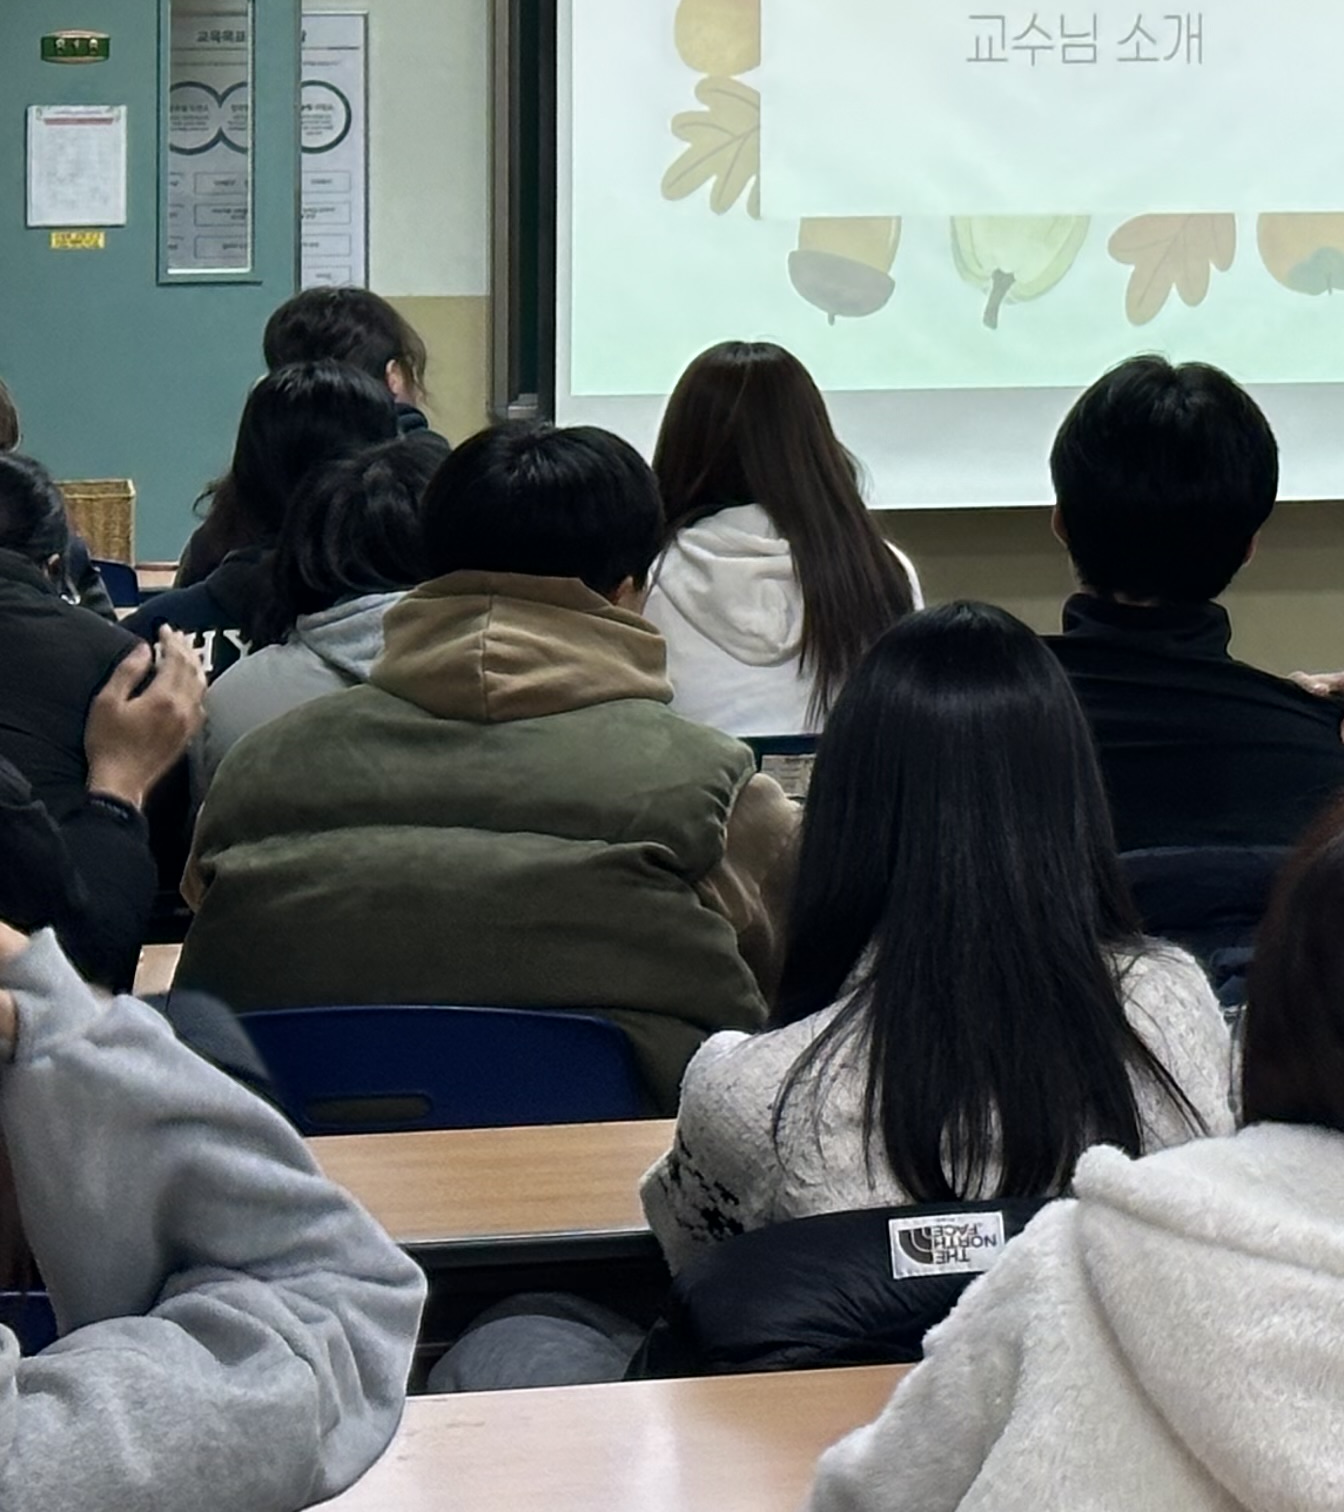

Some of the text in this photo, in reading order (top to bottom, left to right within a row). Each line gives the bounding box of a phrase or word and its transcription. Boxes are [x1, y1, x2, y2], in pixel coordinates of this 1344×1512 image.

[966, 13, 1204, 65] 교수님 소개
[933, 1223, 978, 1237] FACE
[933, 1234, 998, 1248] NORTH
[935, 1248, 971, 1265] THE
